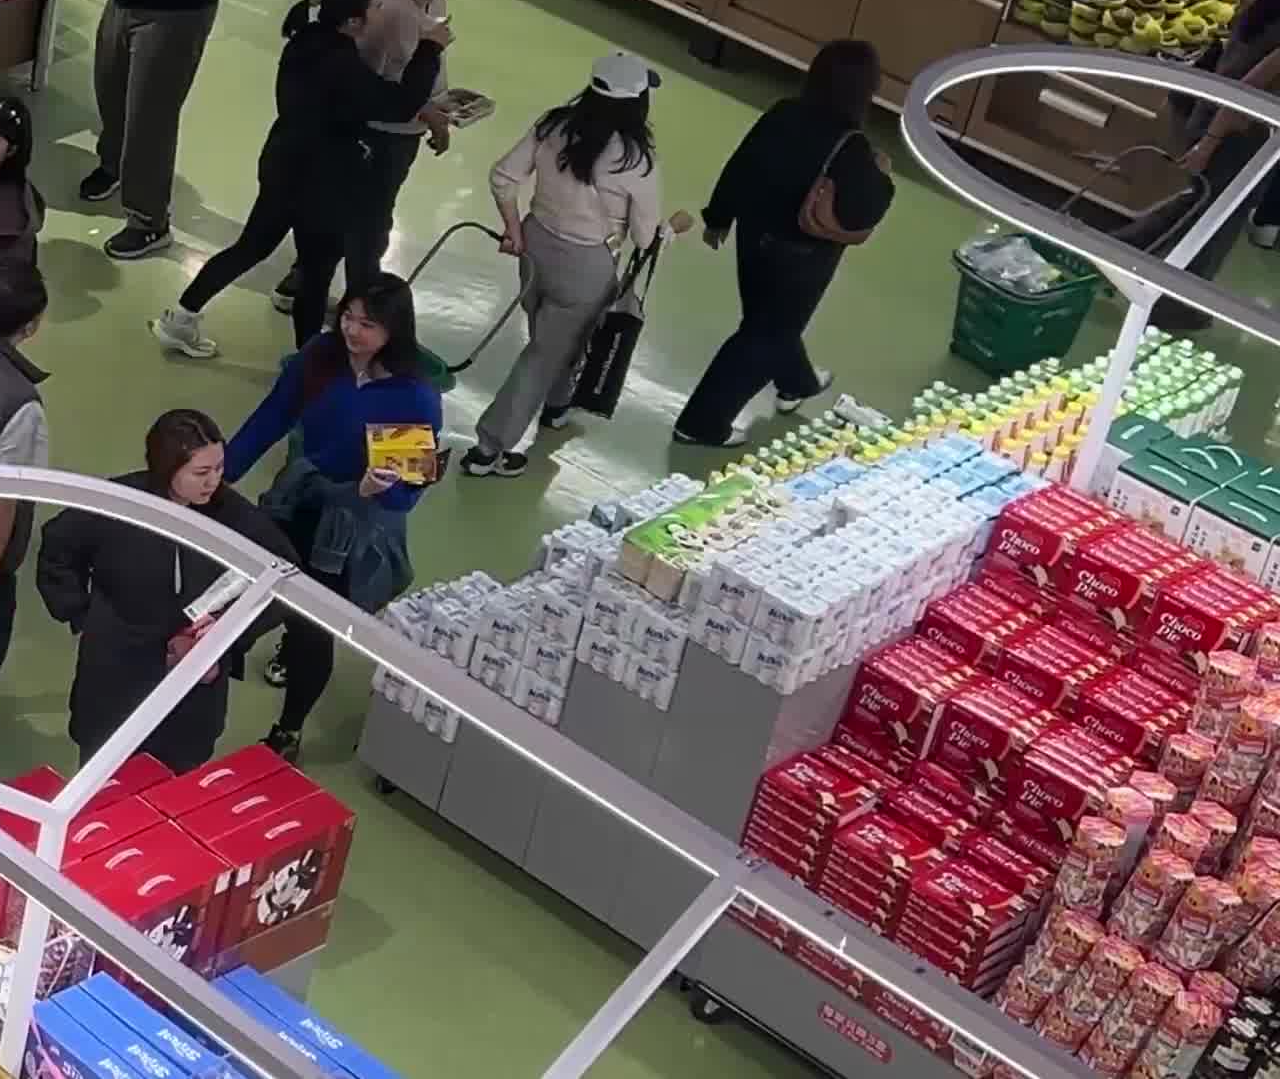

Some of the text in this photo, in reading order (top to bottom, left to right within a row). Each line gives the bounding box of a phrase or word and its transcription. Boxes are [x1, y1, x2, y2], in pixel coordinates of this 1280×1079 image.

[998, 540, 1022, 558] Pie
[1001, 528, 1041, 556] Choco
[1073, 582, 1098, 599] Pie
[1077, 570, 1120, 599] Choco
[926, 626, 966, 656] Choco
[1155, 625, 1181, 643] Pie
[1159, 612, 1202, 642] Choco
[861, 683, 900, 712] Choco
[1004, 669, 1044, 699] Choco
[949, 719, 991, 751] Choco
[1084, 714, 1125, 746] Choco
[1020, 791, 1043, 810] Pie
[1023, 778, 1064, 810] Choco
